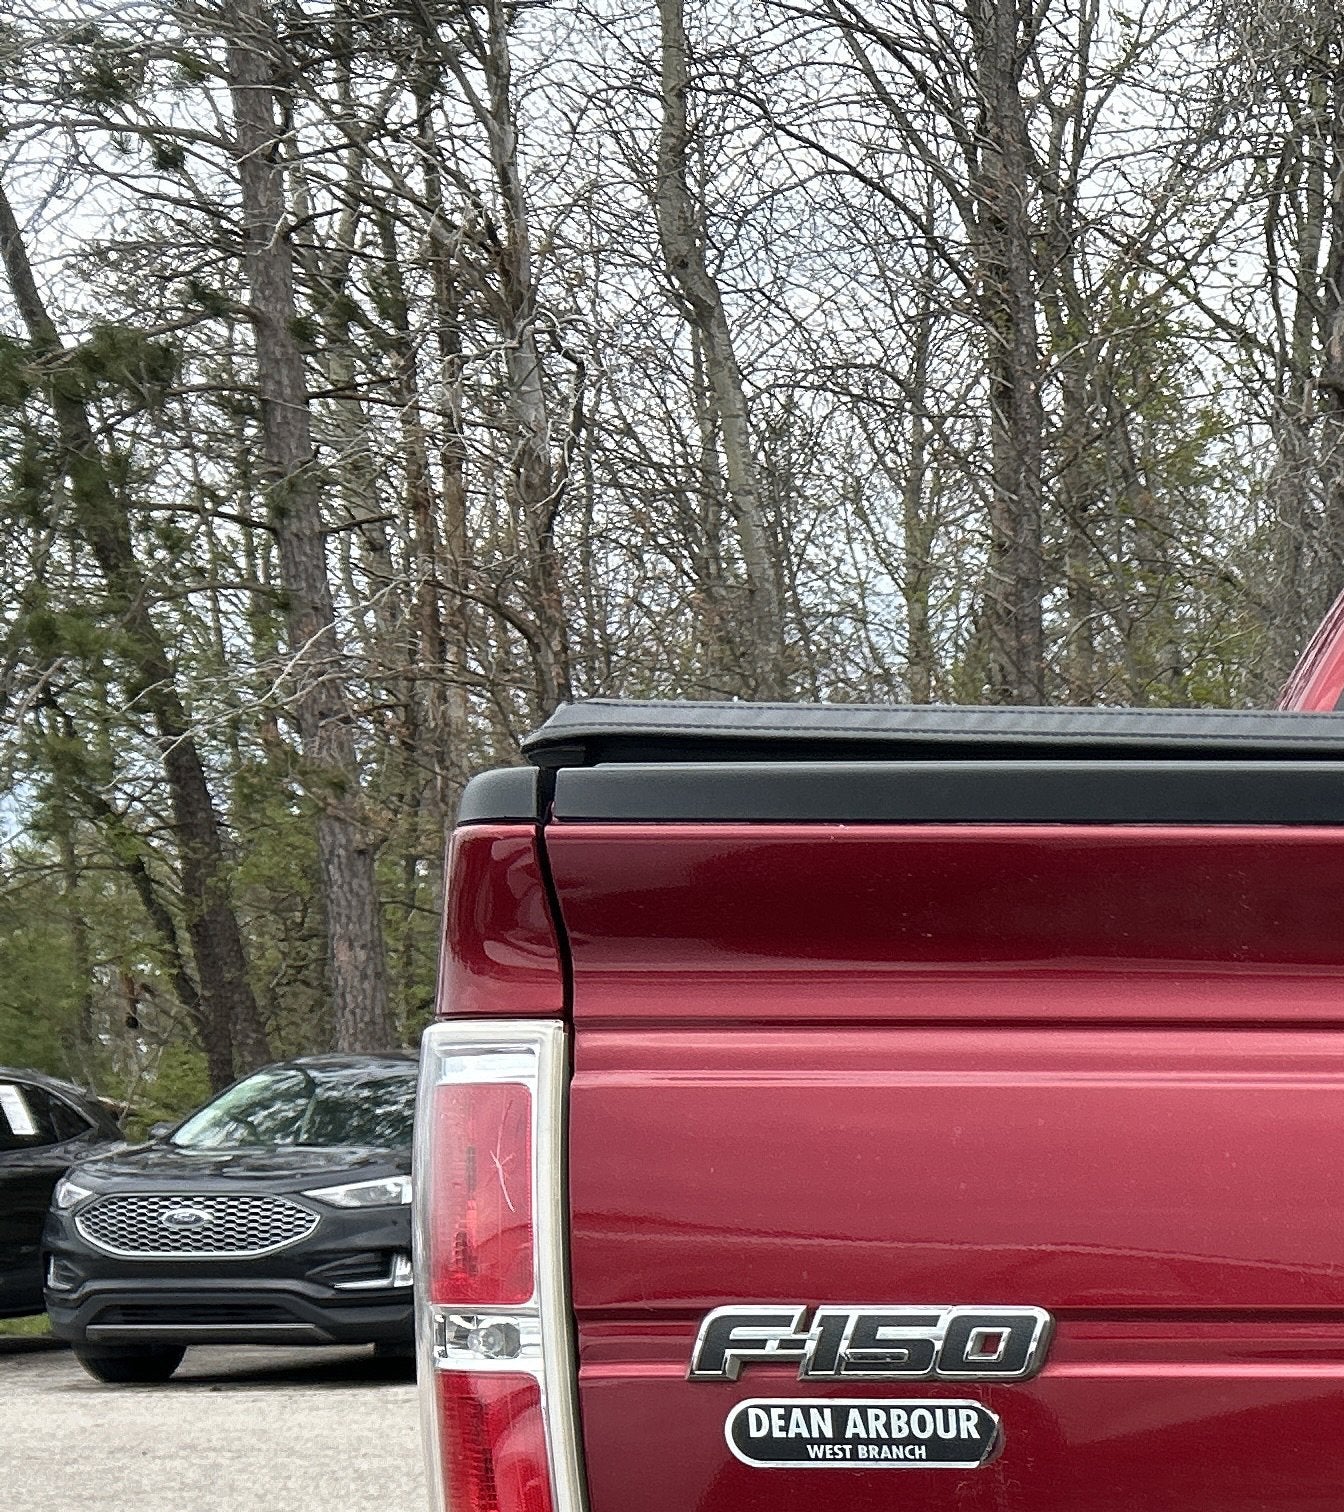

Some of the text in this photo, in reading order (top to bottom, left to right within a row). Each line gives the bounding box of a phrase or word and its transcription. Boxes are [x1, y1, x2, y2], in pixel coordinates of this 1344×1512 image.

[687, 1304, 1054, 1381] F-150
[747, 1406, 981, 1440] DEAN ARBOUR
[807, 1444, 927, 1461] WEST BRANCH
